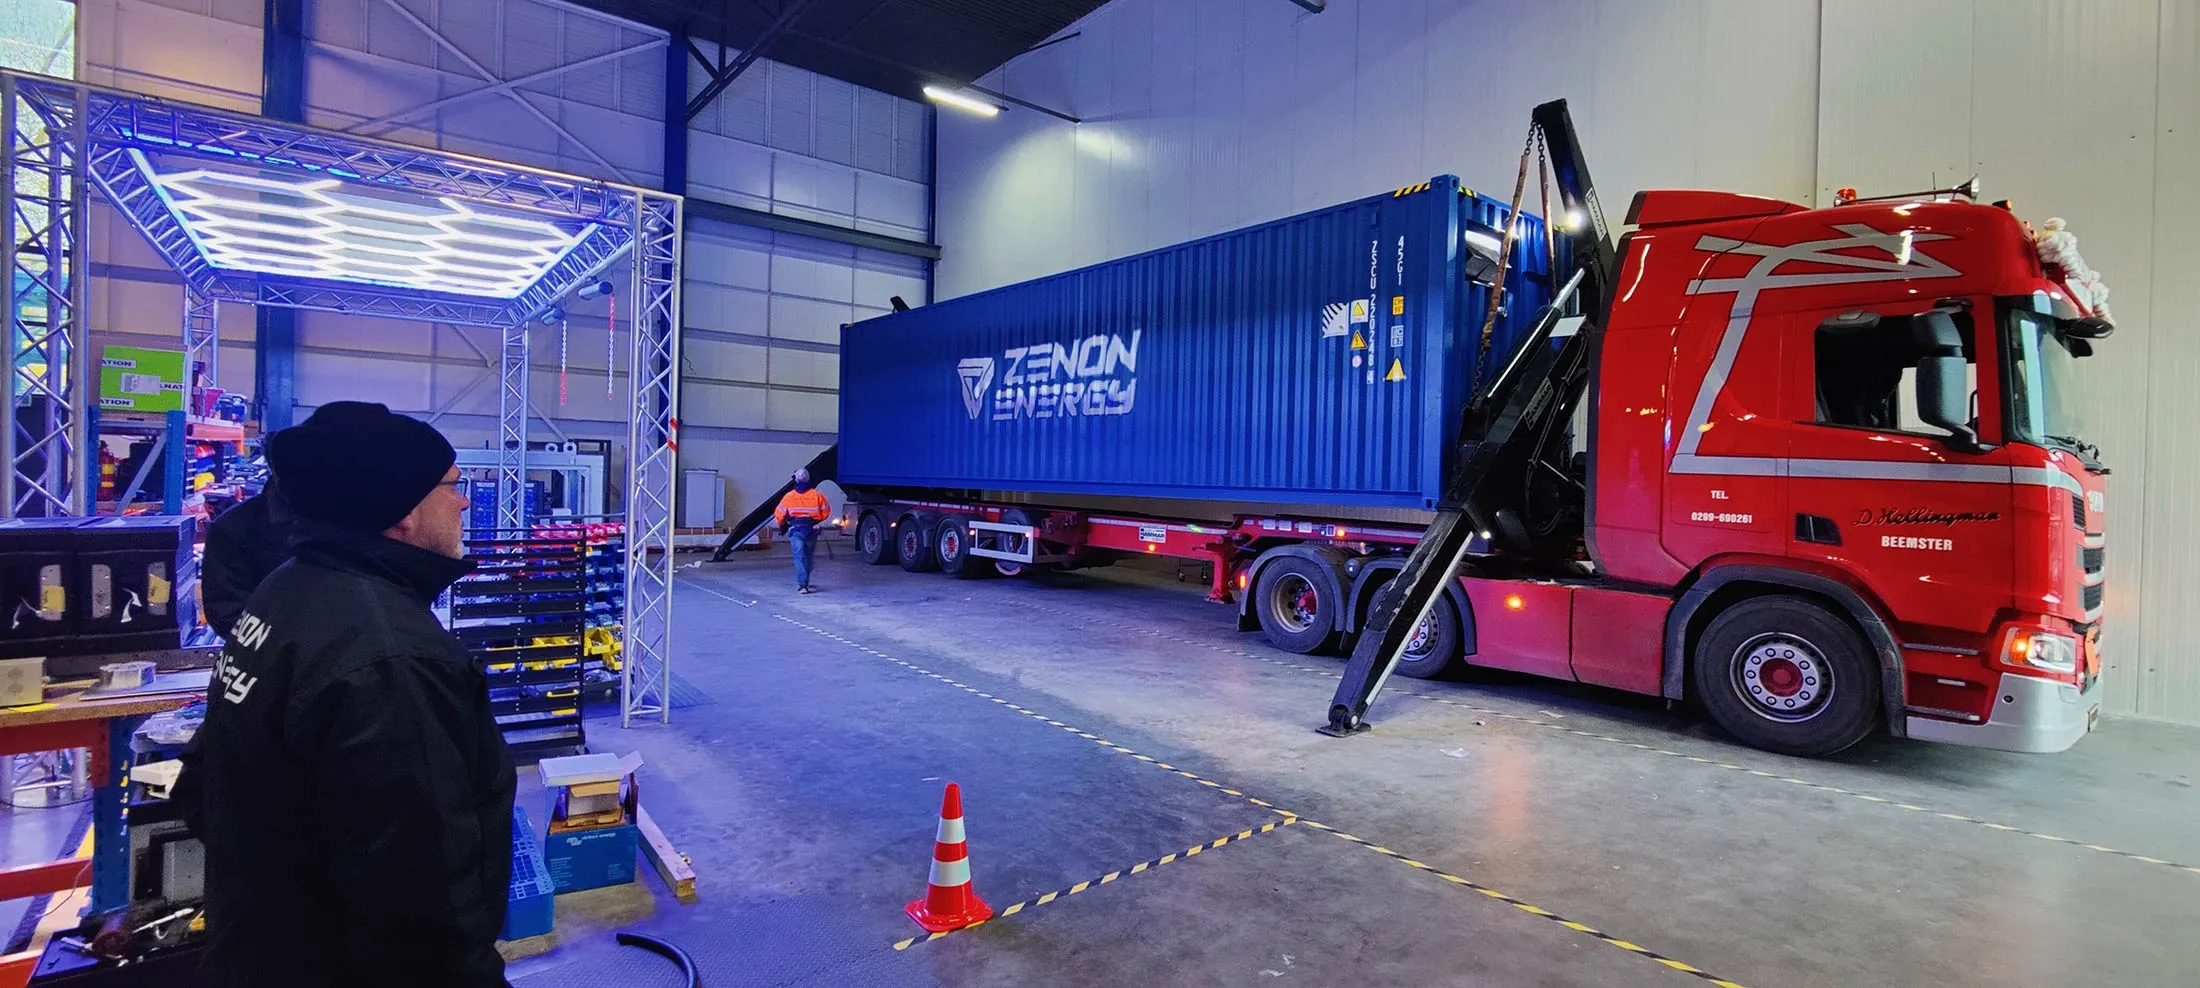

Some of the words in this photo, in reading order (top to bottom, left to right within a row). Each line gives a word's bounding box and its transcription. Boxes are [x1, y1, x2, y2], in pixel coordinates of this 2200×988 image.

[1004, 329, 1141, 386] ZENON
[992, 377, 1137, 421] ENERGY
[1881, 535, 1953, 551] BEEMSTER
